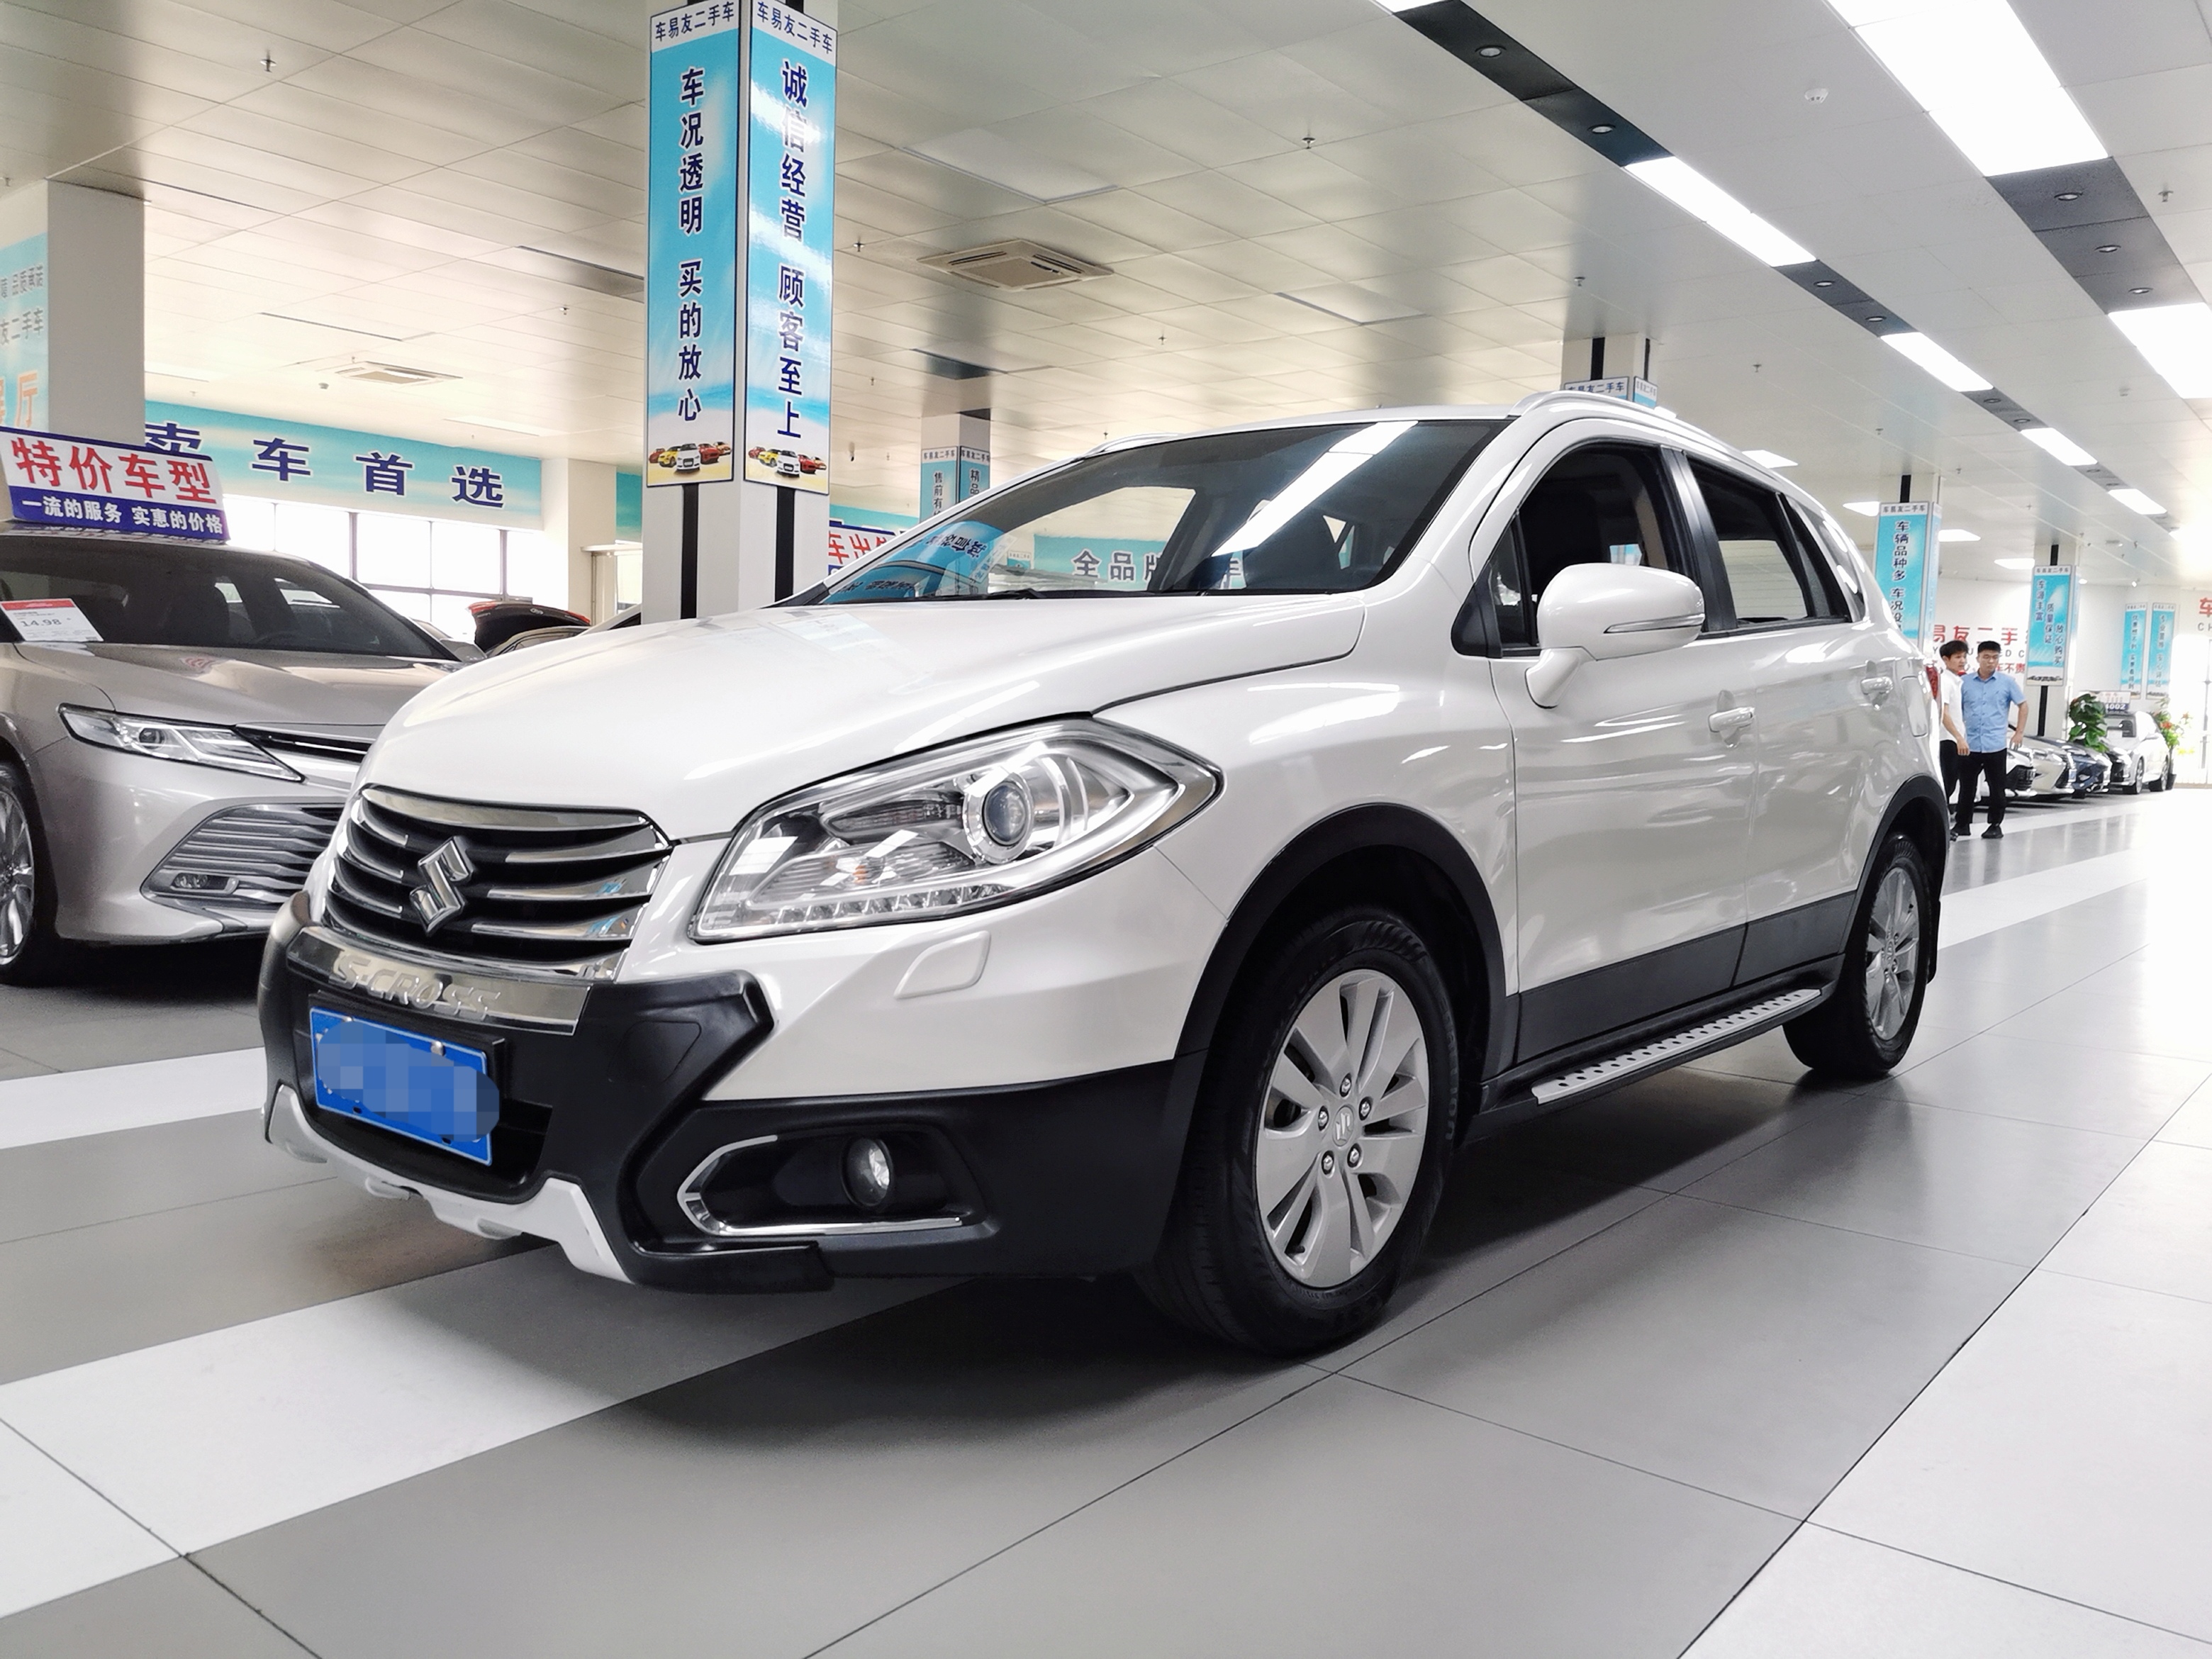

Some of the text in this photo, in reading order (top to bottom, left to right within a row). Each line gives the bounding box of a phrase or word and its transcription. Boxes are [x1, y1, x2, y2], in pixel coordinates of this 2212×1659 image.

[655, 1, 734, 41] 车易友二手车
[757, 1, 832, 54] 车易友二手车
[680, 68, 704, 234] 车况透明
[781, 61, 808, 242] 诚信经营
[678, 260, 702, 421] 买的放心
[777, 265, 804, 438] 顾客至上
[0, 371, 38, 428] 厅
[11, 437, 217, 504] 特价车型
[934, 471, 944, 515] 售前有
[22, 496, 224, 535] 一流的服务 实惠的价格
[1892, 520, 1910, 581] 车辆品种多
[20, 618, 62, 627] 14.98
